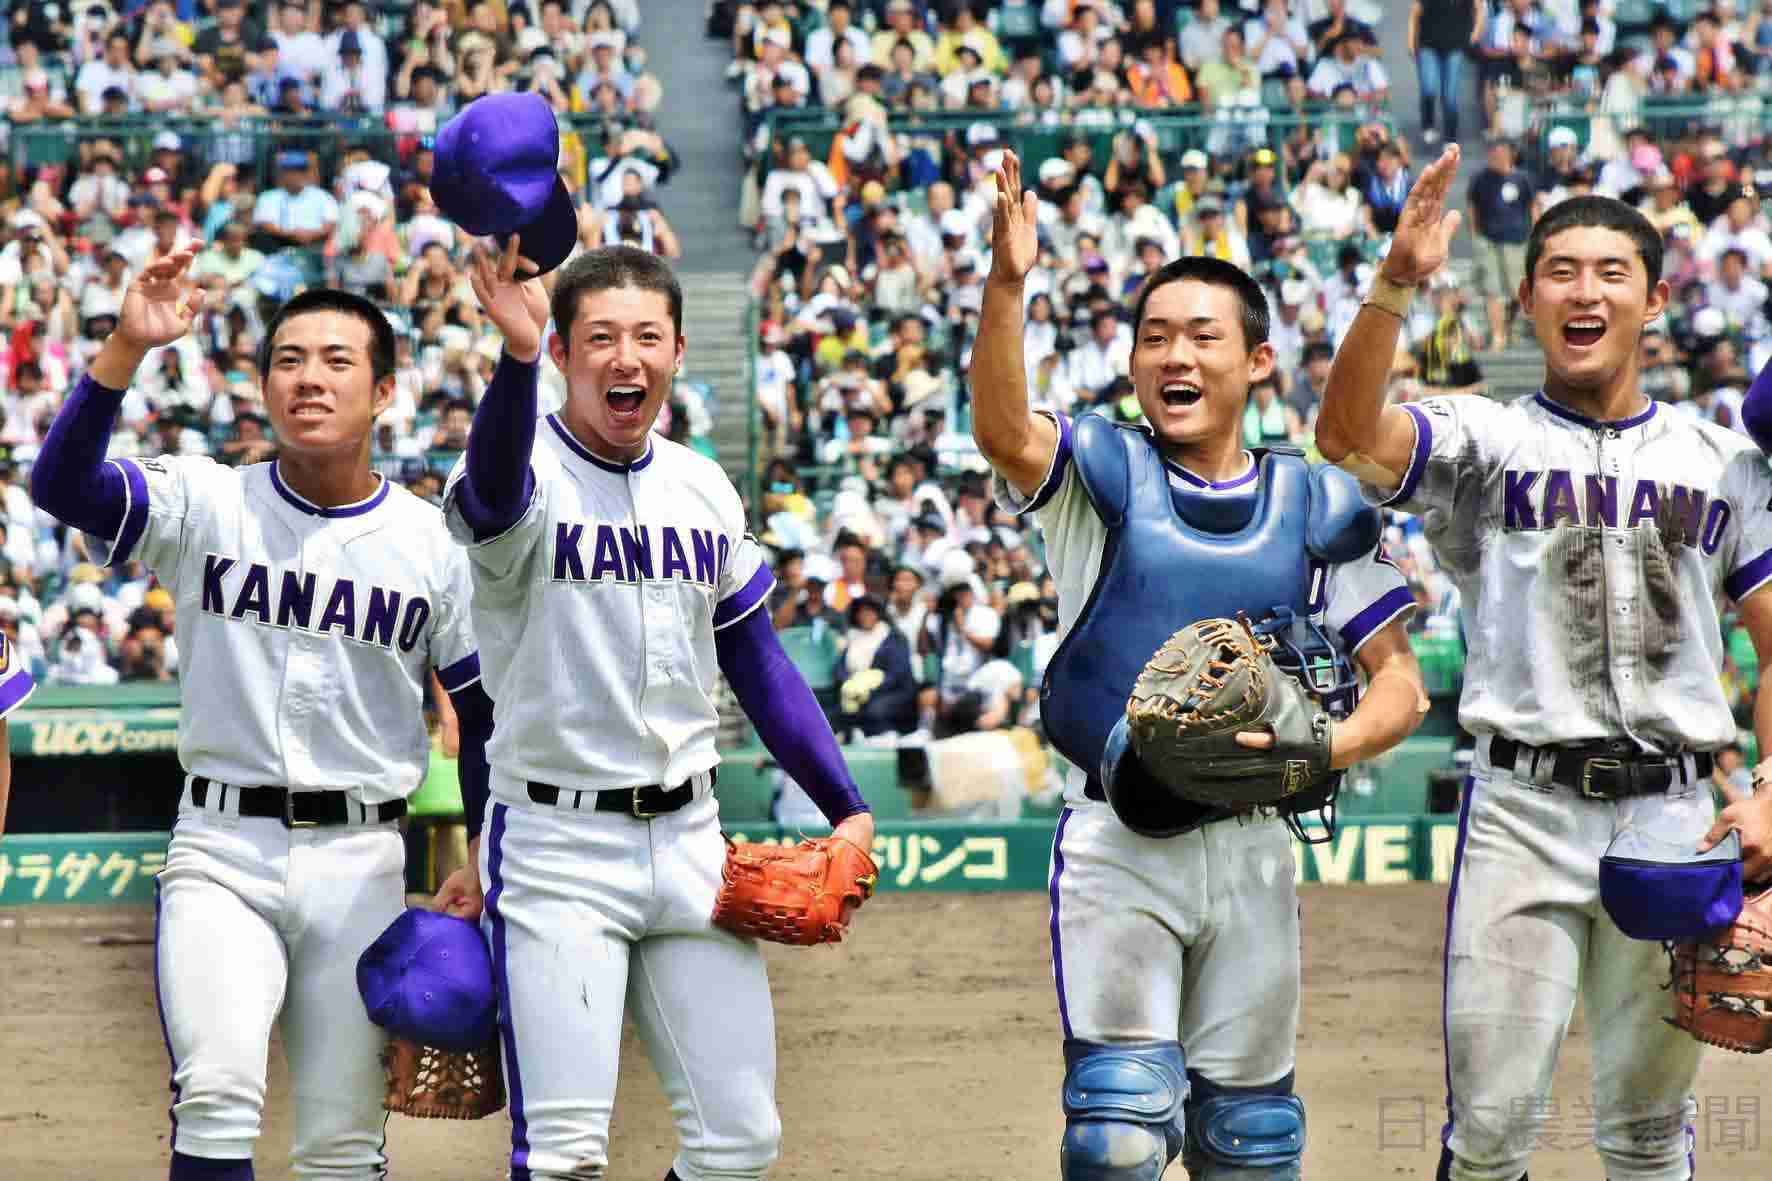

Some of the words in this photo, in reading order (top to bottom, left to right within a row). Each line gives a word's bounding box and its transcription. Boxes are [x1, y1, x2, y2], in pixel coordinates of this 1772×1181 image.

[1503, 468, 1731, 557] KANANO
[552, 521, 730, 592] KANANO
[201, 552, 431, 653] KANANO
[33, 721, 126, 756] UCC
